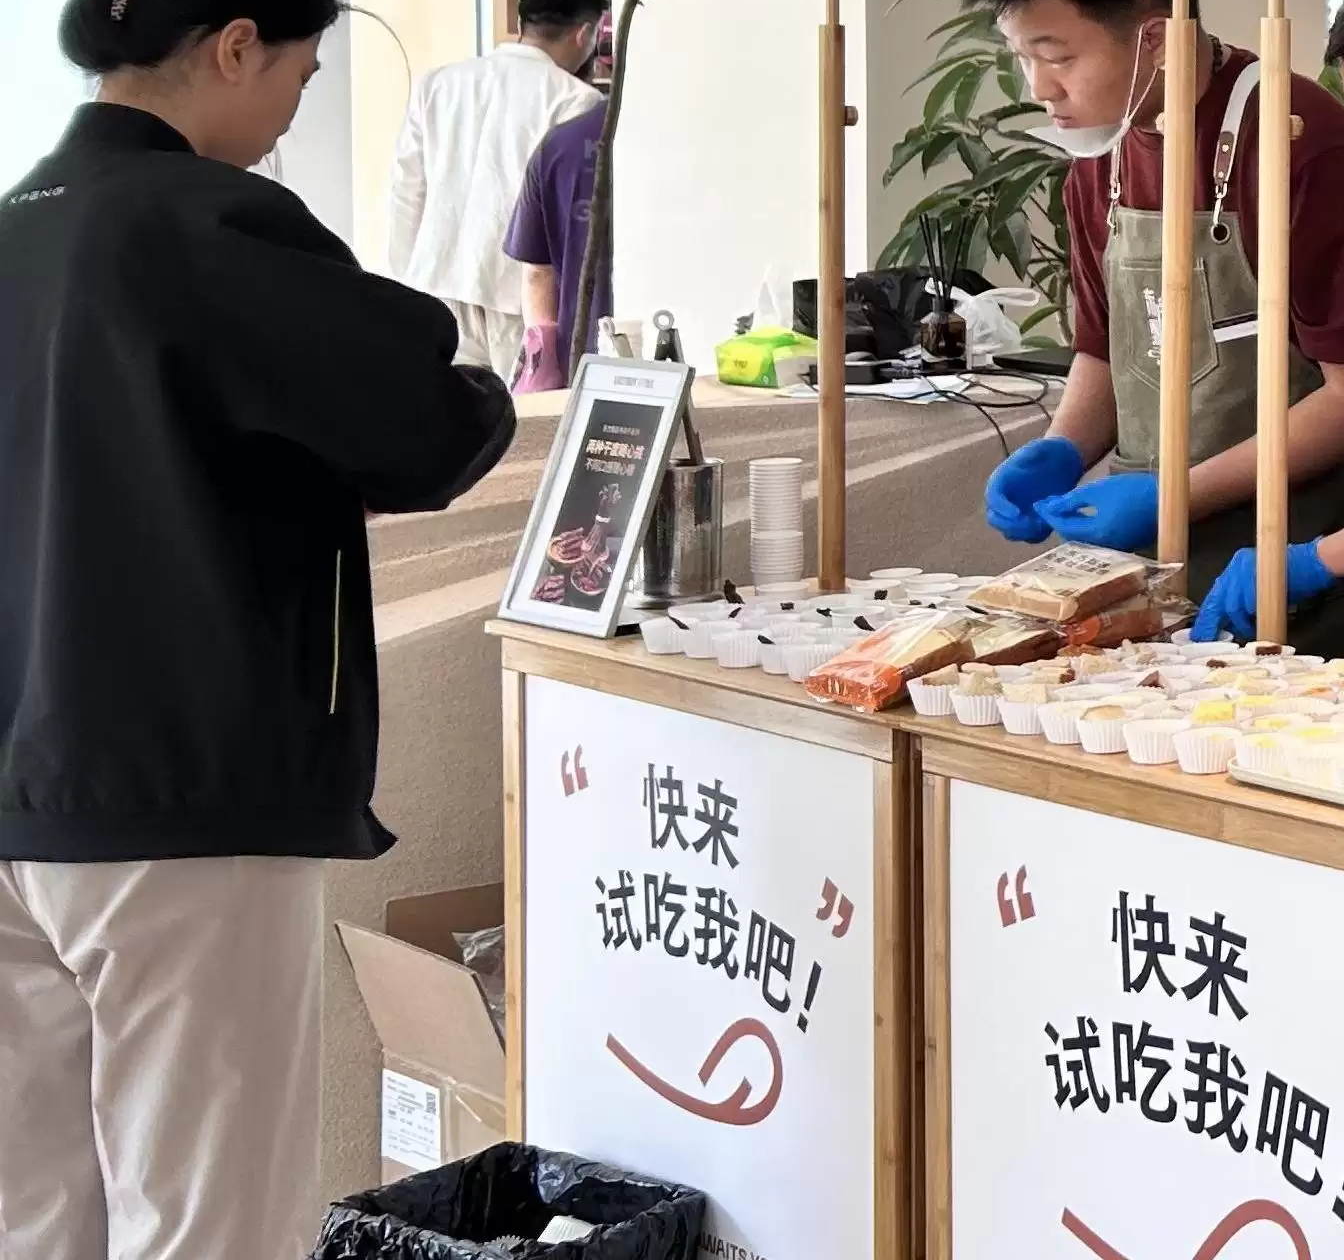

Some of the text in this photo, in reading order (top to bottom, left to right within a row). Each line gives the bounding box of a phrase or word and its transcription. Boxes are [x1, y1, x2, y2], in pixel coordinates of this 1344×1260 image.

[643, 762, 740, 870] 快来
[595, 869, 824, 1034] 试吃我吧!
[1112, 891, 1249, 1022] 快来
[696, 1232, 748, 1260] WAITS
